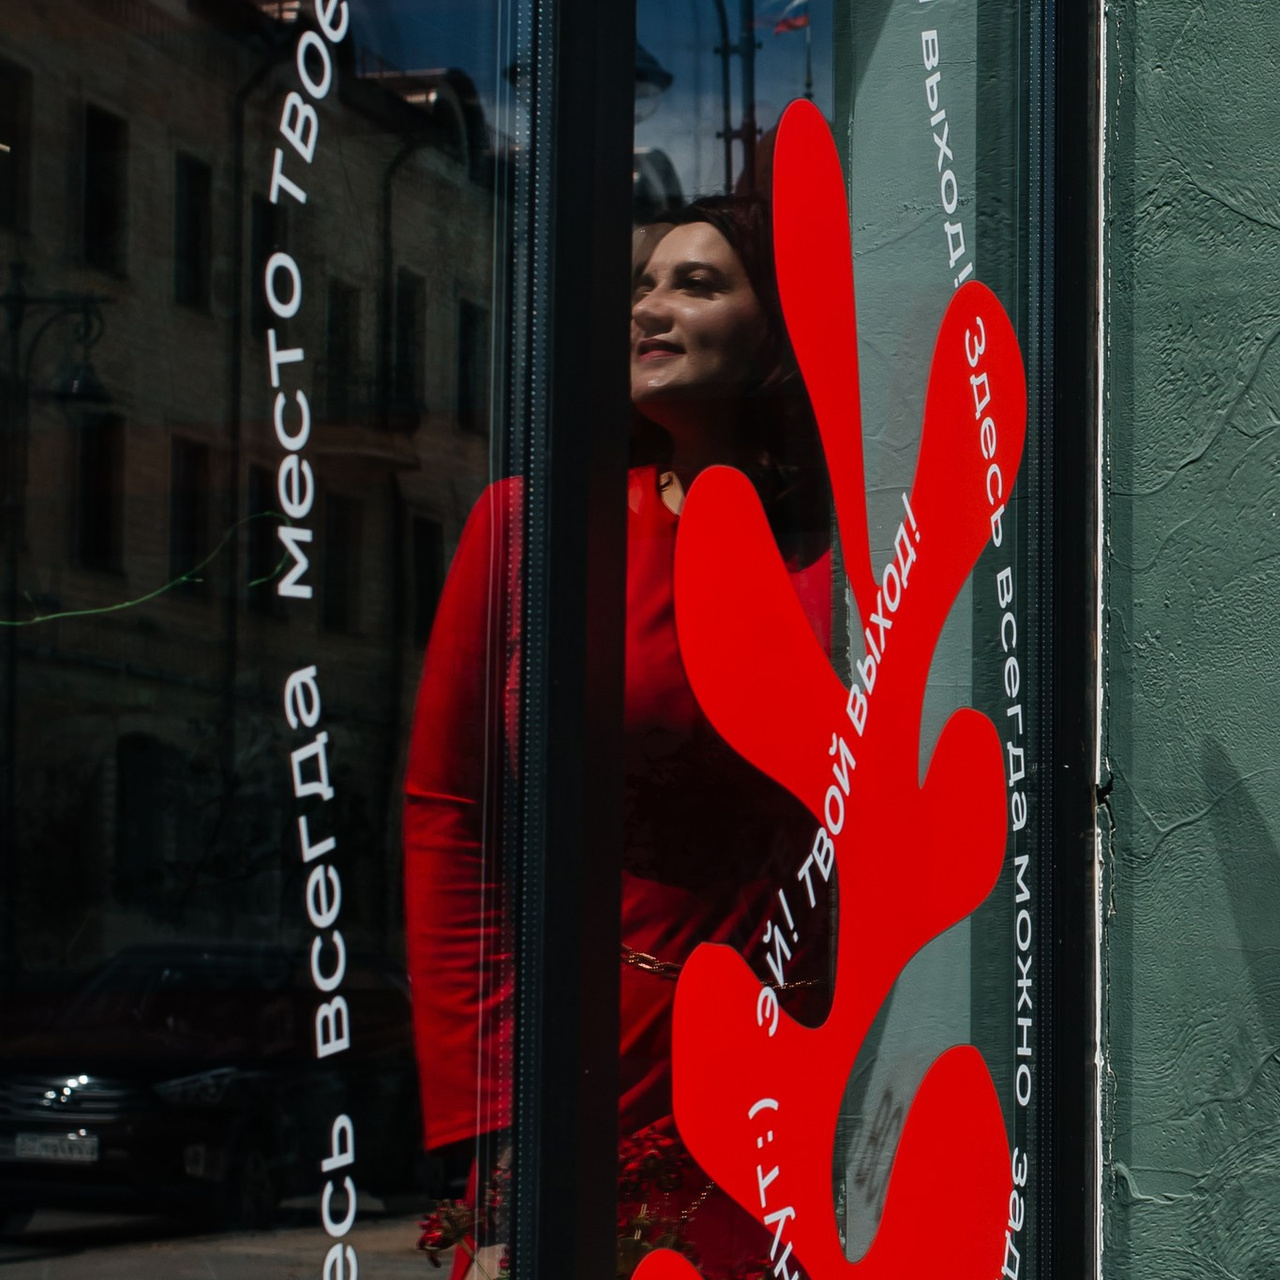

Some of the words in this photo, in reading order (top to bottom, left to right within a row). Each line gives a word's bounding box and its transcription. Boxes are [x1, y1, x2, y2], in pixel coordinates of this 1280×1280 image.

[264, 252, 314, 600] место
[284, 665, 350, 1059] всегда
[965, 316, 1006, 548] здесь
[996, 566, 1028, 832] всегда
[1012, 854, 1032, 1107] можно
